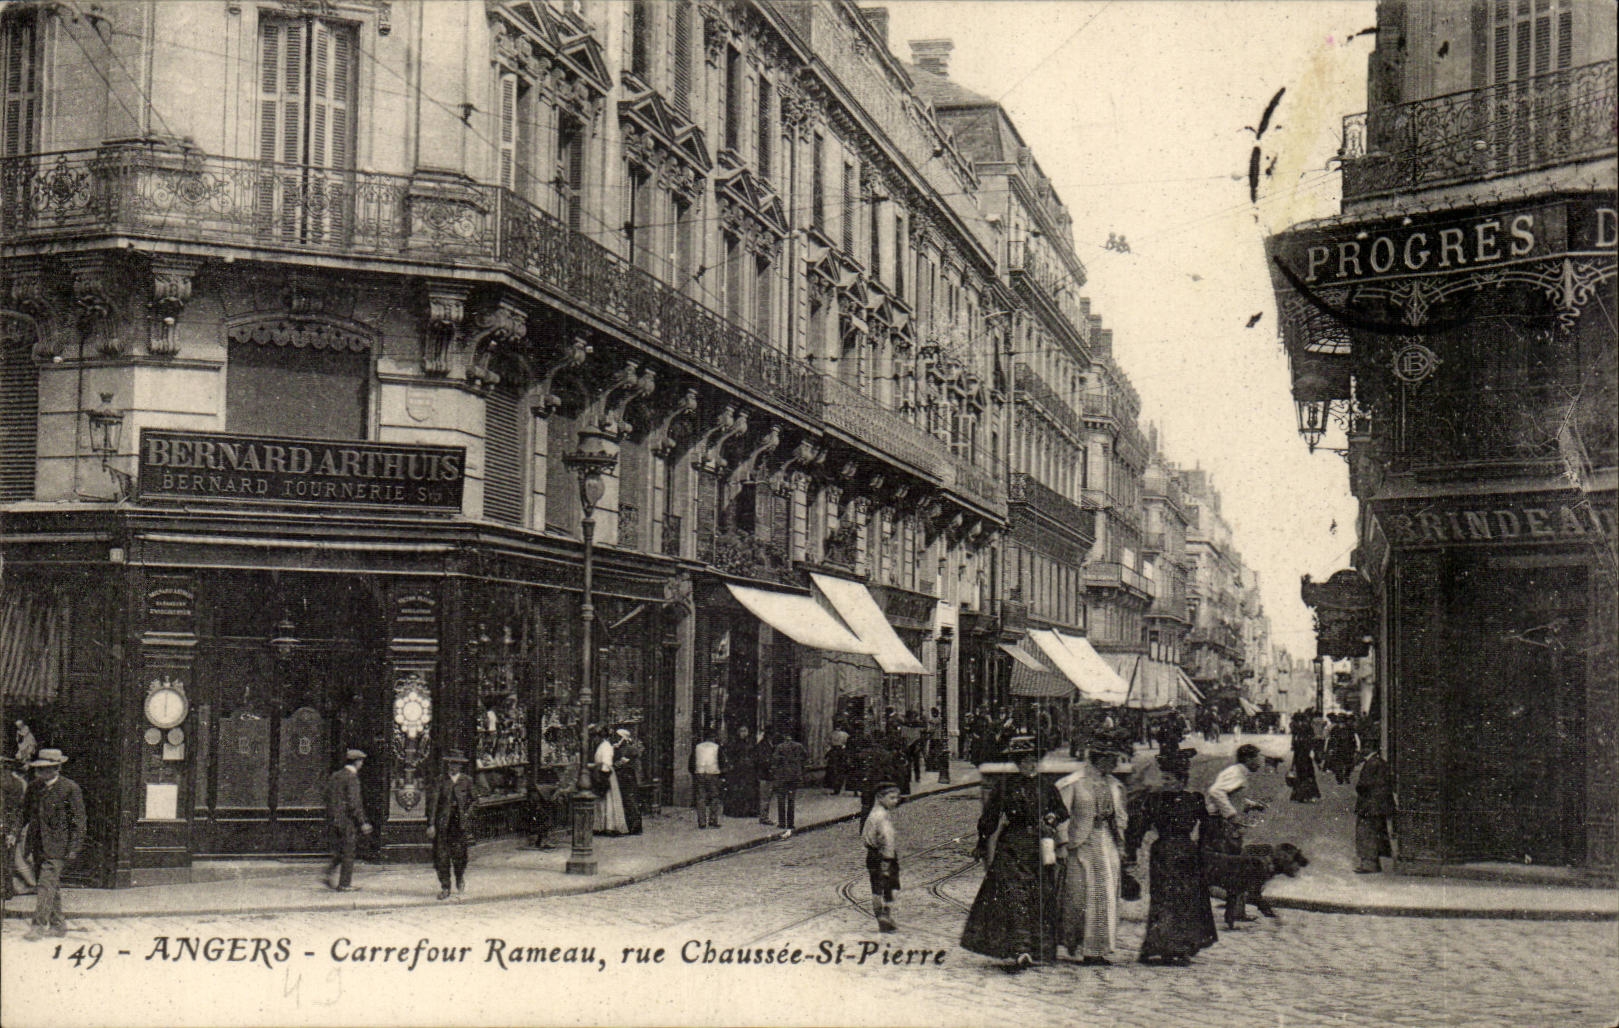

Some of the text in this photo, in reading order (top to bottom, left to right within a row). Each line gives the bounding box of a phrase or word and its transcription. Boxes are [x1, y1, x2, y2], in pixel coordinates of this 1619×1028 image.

[145, 438, 461, 481] BERNARD ARTHUIS
[163, 474, 269, 495] BERNARD
[283, 480, 405, 501] TOURNERIE
